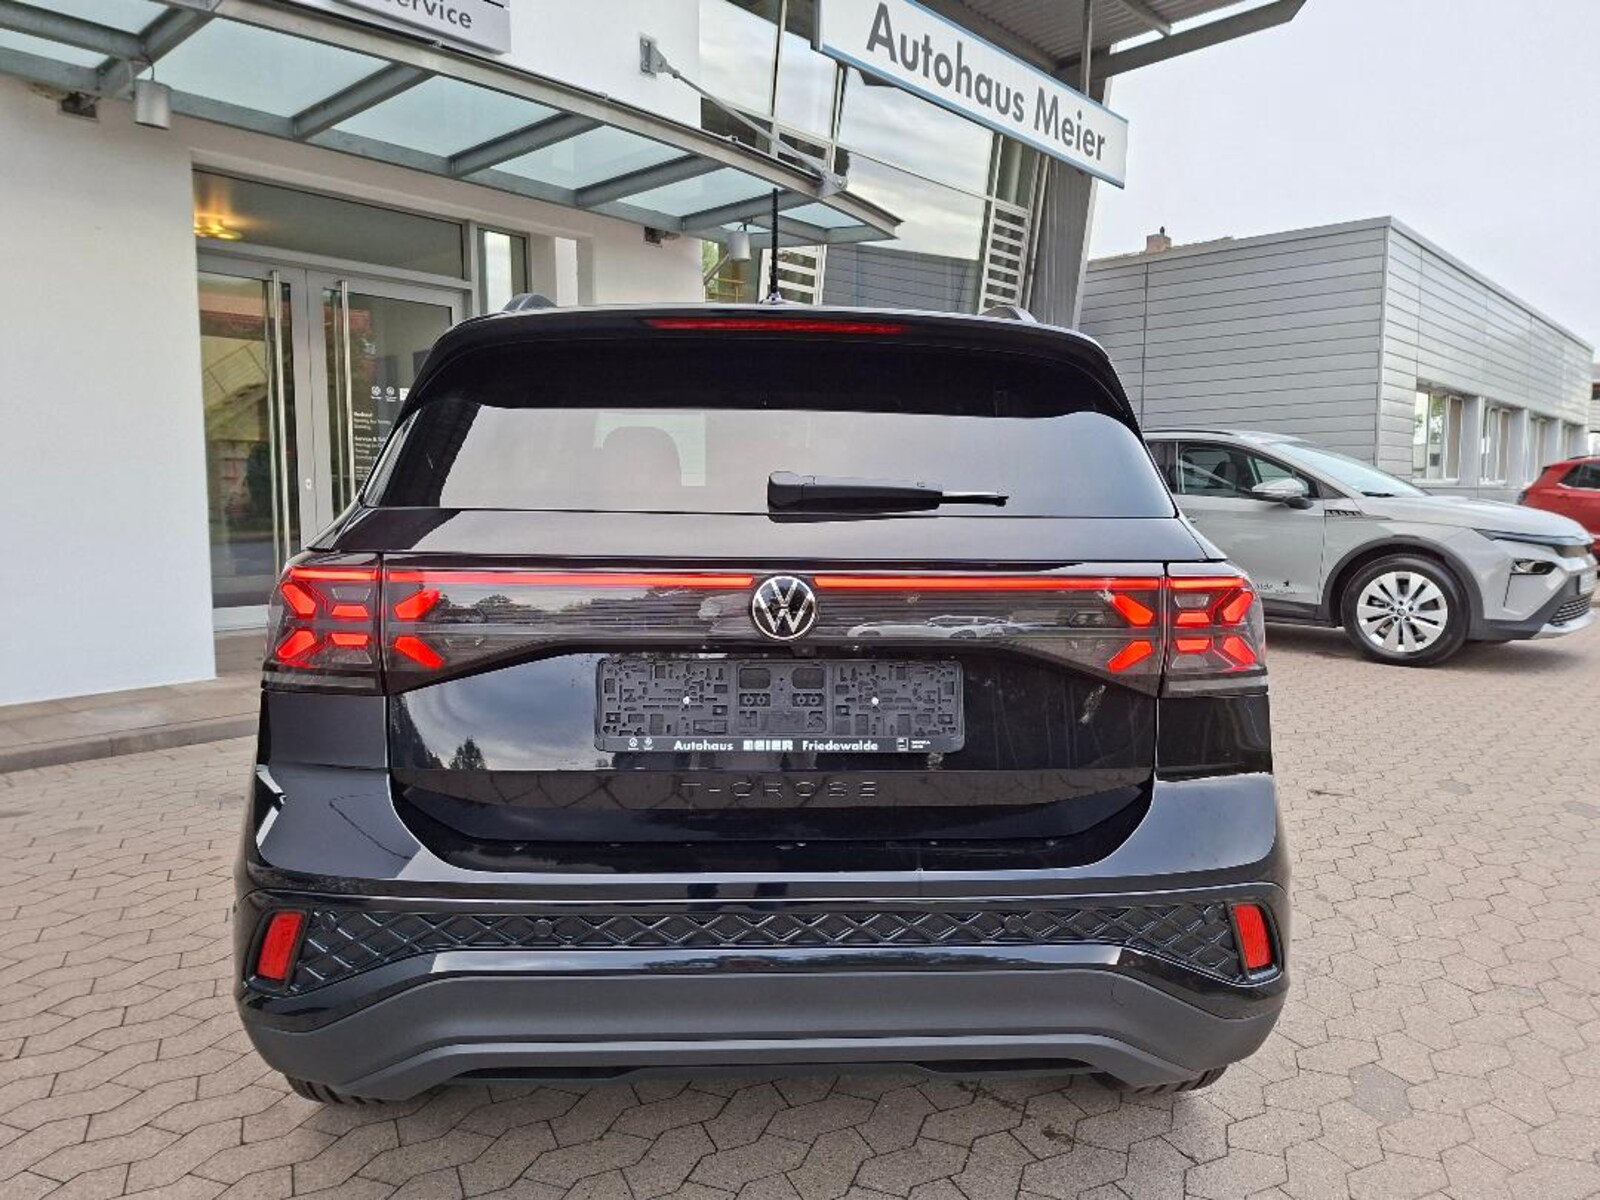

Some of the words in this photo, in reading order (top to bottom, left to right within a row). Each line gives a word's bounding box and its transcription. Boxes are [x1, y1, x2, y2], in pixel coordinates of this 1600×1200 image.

[386, 0, 472, 29] ervice
[866, 2, 1025, 123] Autohaus
[1033, 86, 1106, 161] Meier
[673, 739, 734, 751] Autohaus
[802, 740, 879, 751] Friedewalde
[681, 782, 878, 799] T-CROSS
